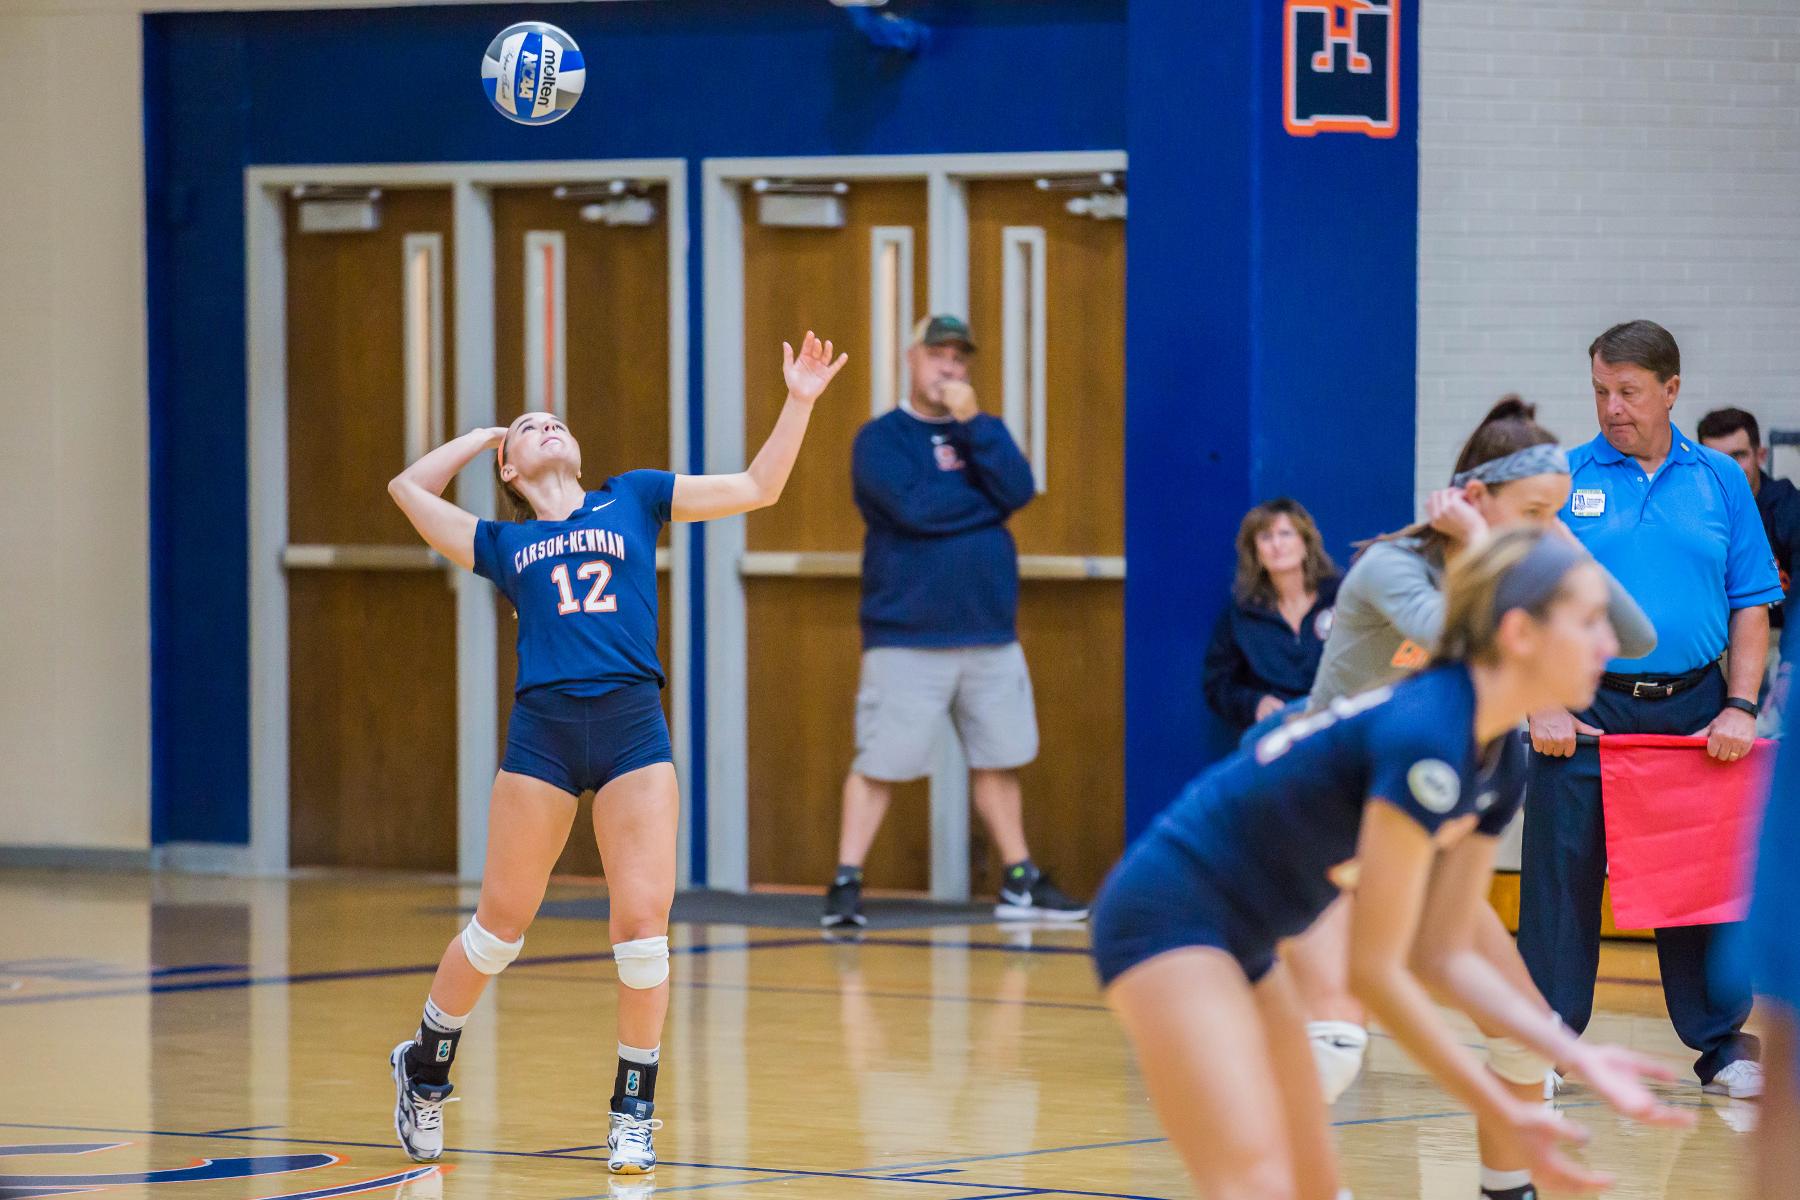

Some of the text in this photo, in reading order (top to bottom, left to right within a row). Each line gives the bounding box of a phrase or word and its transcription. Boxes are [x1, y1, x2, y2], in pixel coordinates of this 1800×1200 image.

[538, 50, 556, 105] molten
[1283, 0, 1401, 138] E
[514, 529, 625, 574] CARSON-NEWMAN
[551, 559, 617, 616] 12
